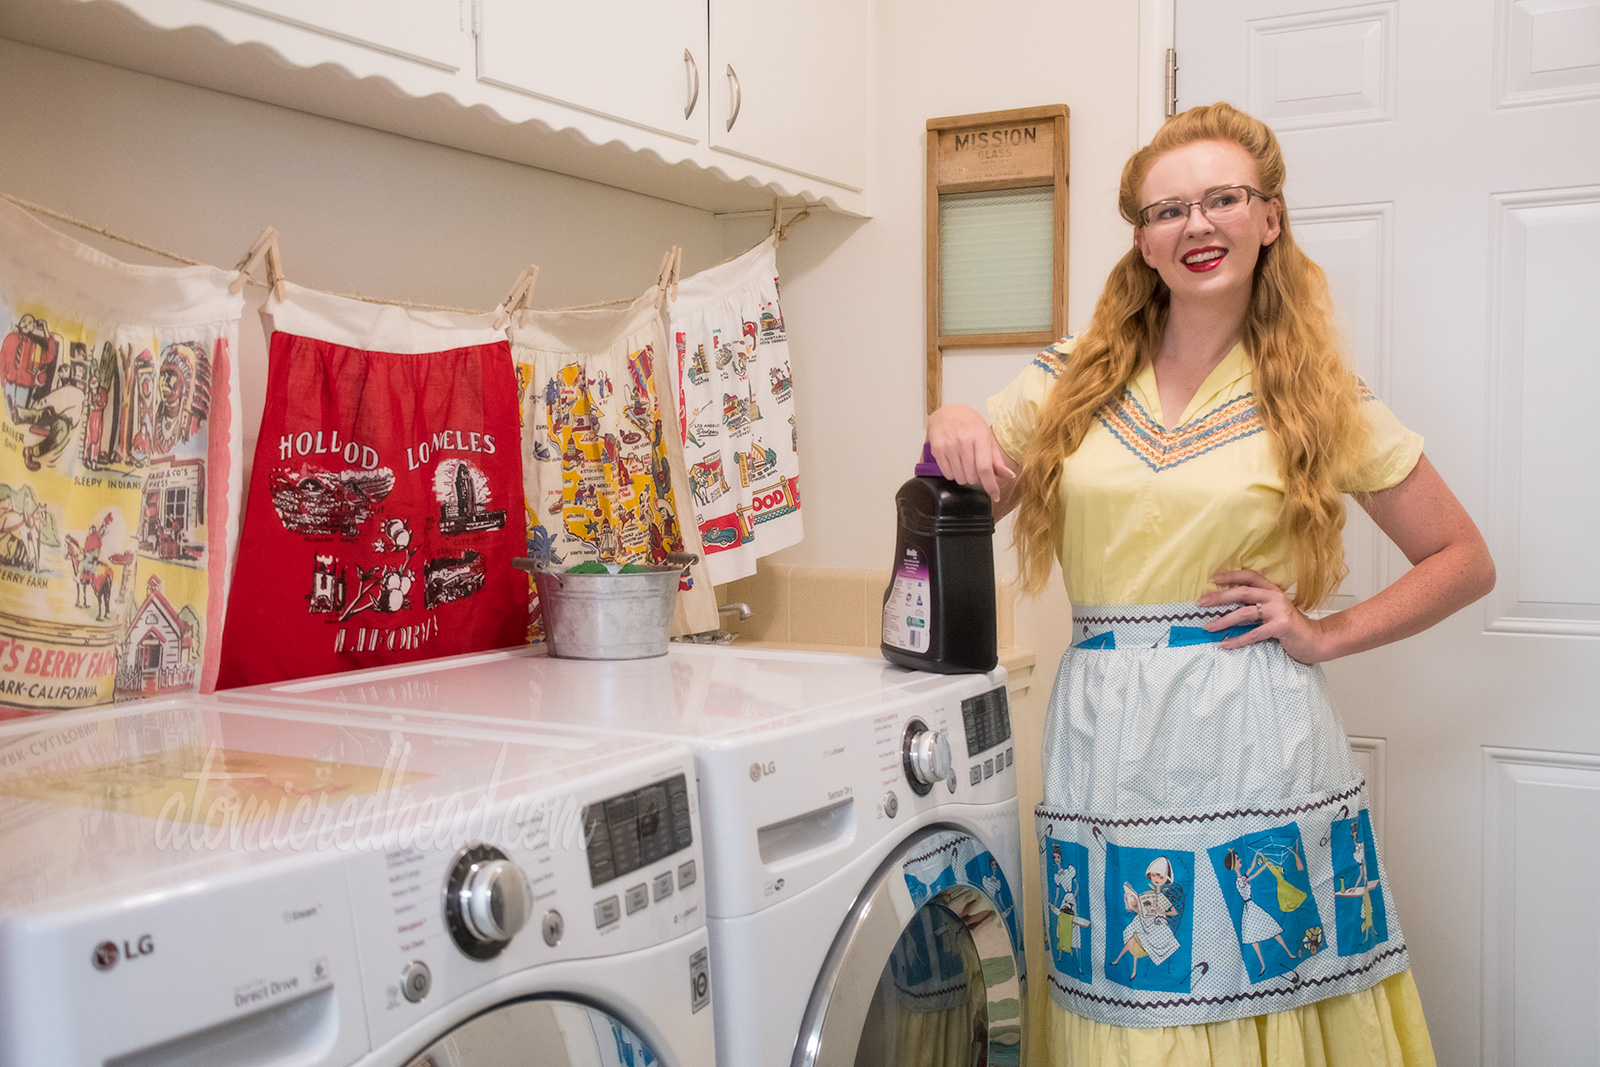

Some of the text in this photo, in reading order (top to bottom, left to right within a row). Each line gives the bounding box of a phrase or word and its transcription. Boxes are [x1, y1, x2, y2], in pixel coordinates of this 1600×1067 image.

[954, 127, 1036, 152] MISSION
[977, 148, 1012, 160] GLASS
[172, 468, 189, 477] CO'S
[74, 476, 142, 490] SLEEPY INDIANS
[24, 646, 89, 679] BERRY
[762, 760, 776, 777] LG
[827, 786, 853, 801] Sensor Dry
[124, 934, 155, 960] LG
[234, 986, 268, 1008] Direct
[270, 977, 299, 995] Drive
